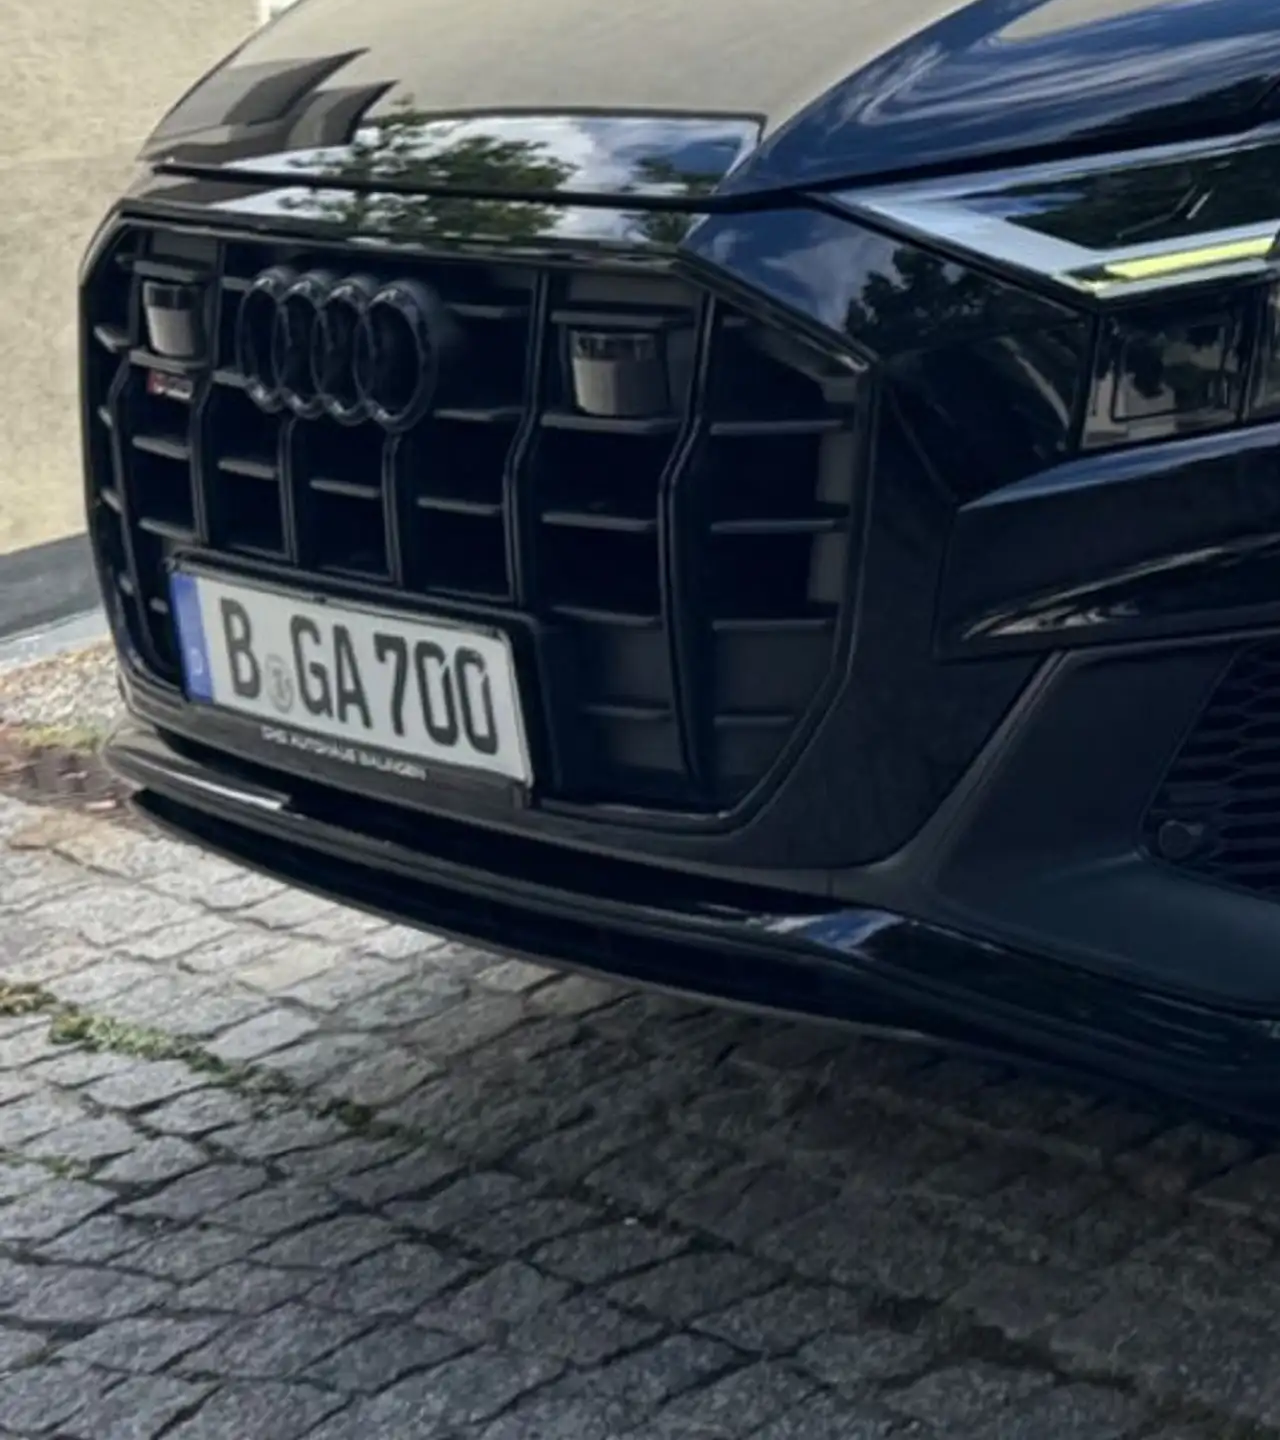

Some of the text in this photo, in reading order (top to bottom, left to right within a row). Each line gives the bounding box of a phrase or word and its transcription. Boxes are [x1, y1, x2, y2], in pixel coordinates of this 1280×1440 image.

[220, 596, 498, 756] B GA 700
